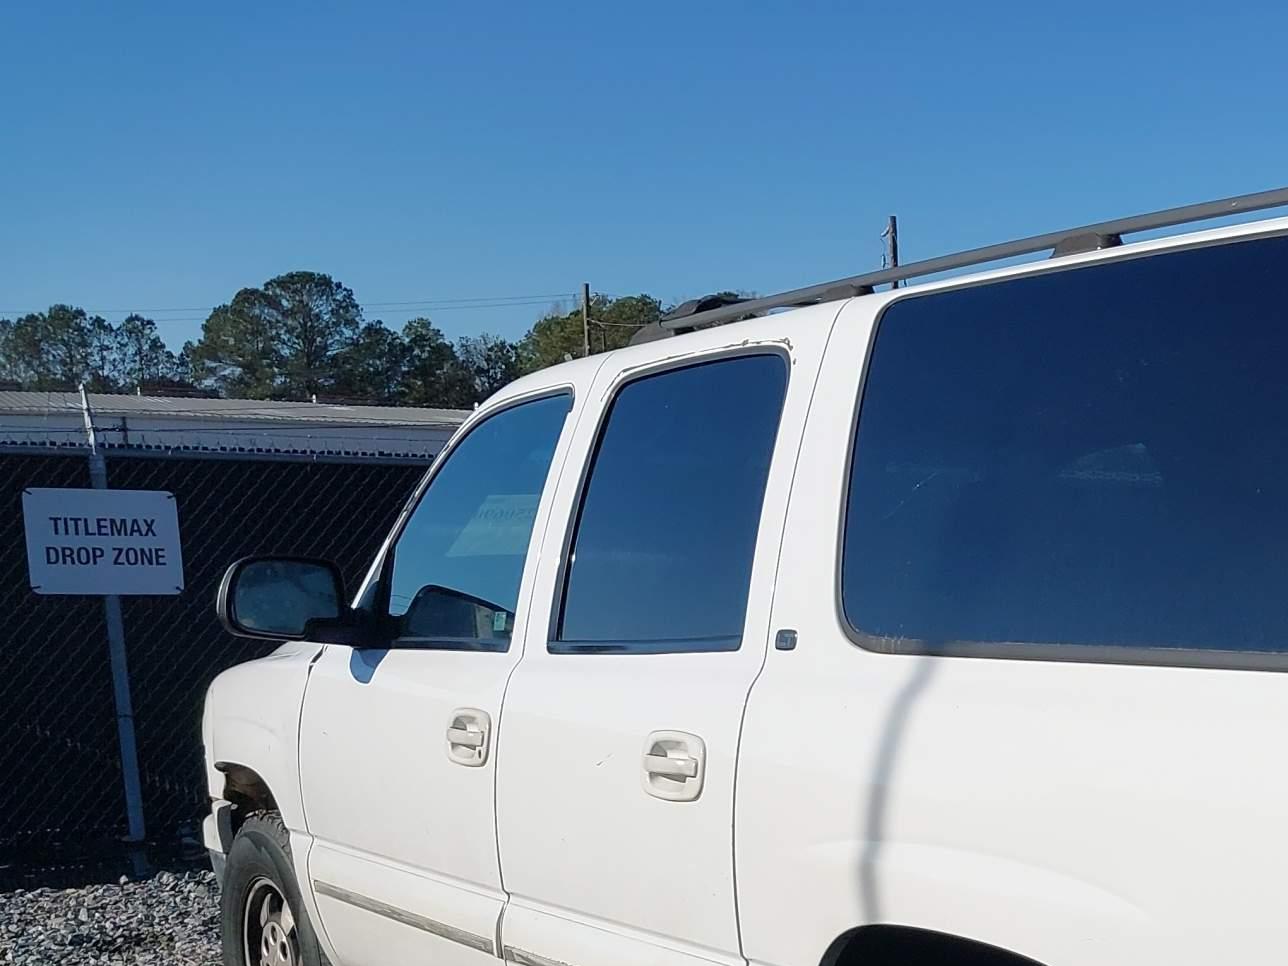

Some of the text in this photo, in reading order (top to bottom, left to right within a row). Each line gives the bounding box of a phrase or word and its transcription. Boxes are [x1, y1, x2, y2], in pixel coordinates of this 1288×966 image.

[48, 516, 158, 537] TITLEMAX
[45, 546, 168, 566] DROP ZONE
